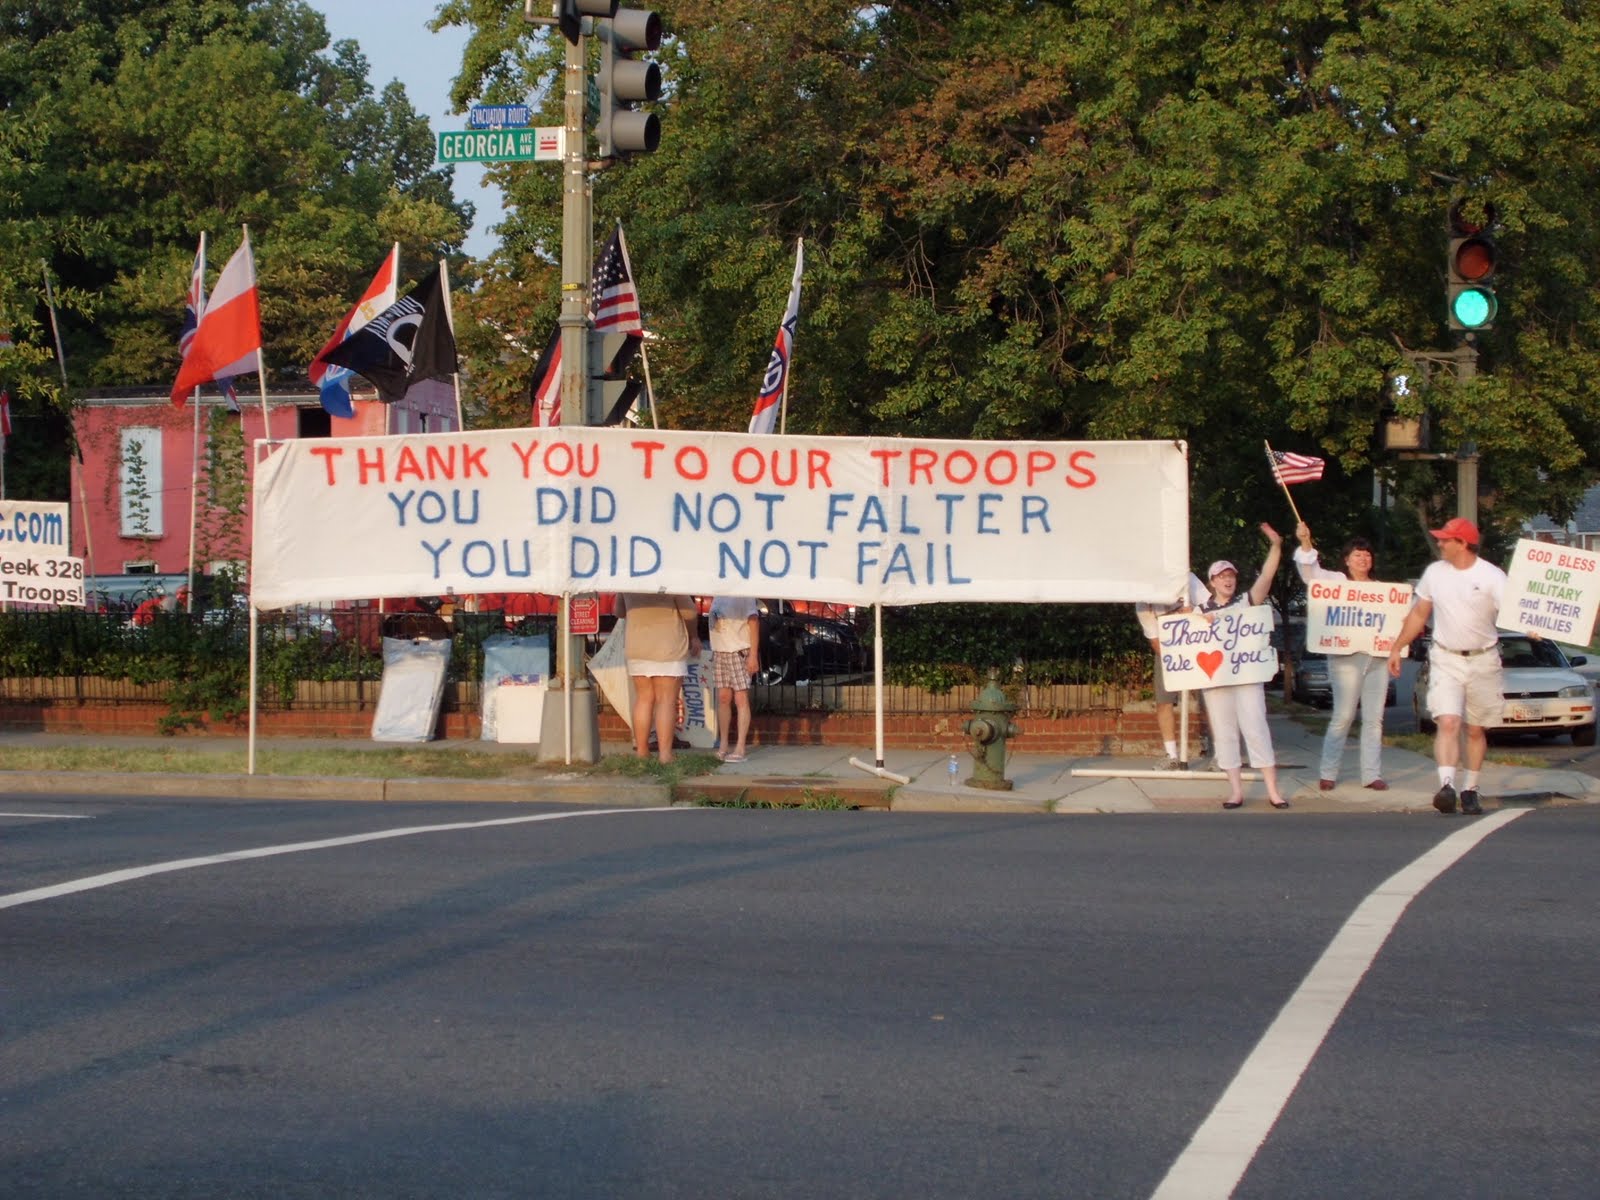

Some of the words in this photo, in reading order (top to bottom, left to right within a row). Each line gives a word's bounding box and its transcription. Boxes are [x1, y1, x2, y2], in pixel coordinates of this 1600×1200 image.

[472, 108, 506, 124] EVACUATION
[507, 107, 527, 123] ROUTE
[443, 133, 516, 158] GEORGIA
[519, 133, 532, 143] AVE
[519, 145, 532, 155] NW
[310, 445, 489, 486] THANK
[511, 440, 600, 479] YOU
[631, 441, 709, 480] TO
[731, 447, 833, 488] OUR
[870, 448, 1097, 489] TROOPS
[387, 489, 480, 526] YOU
[536, 486, 617, 526] DID
[672, 492, 786, 533] NOT
[826, 493, 1052, 535] FALTER
[0, 557, 40, 577] eek
[45, 559, 82, 580] 328
[421, 538, 531, 579] YOU
[570, 536, 662, 579] DID
[718, 539, 829, 579] NOT
[857, 542, 971, 585] FAIL
[1527, 549, 1552, 563] GOD
[1558, 554, 1596, 572] BLESS
[1545, 569, 1571, 584] OUR
[3, 581, 83, 607] Troops!
[1311, 584, 1342, 600] God
[1347, 589, 1384, 603] Bless
[1389, 587, 1410, 605] Our
[1527, 580, 1583, 602] MILITARY
[1325, 606, 1386, 633] Military
[1519, 598, 1540, 610] and
[1546, 601, 1581, 619] THEIR
[570, 618, 594, 626] CLEANING
[1161, 618, 1223, 647] Thank
[1223, 614, 1265, 650] You
[1519, 612, 1573, 633] FAMILIES
[1163, 654, 1194, 672] We
[1230, 650, 1270, 675] you
